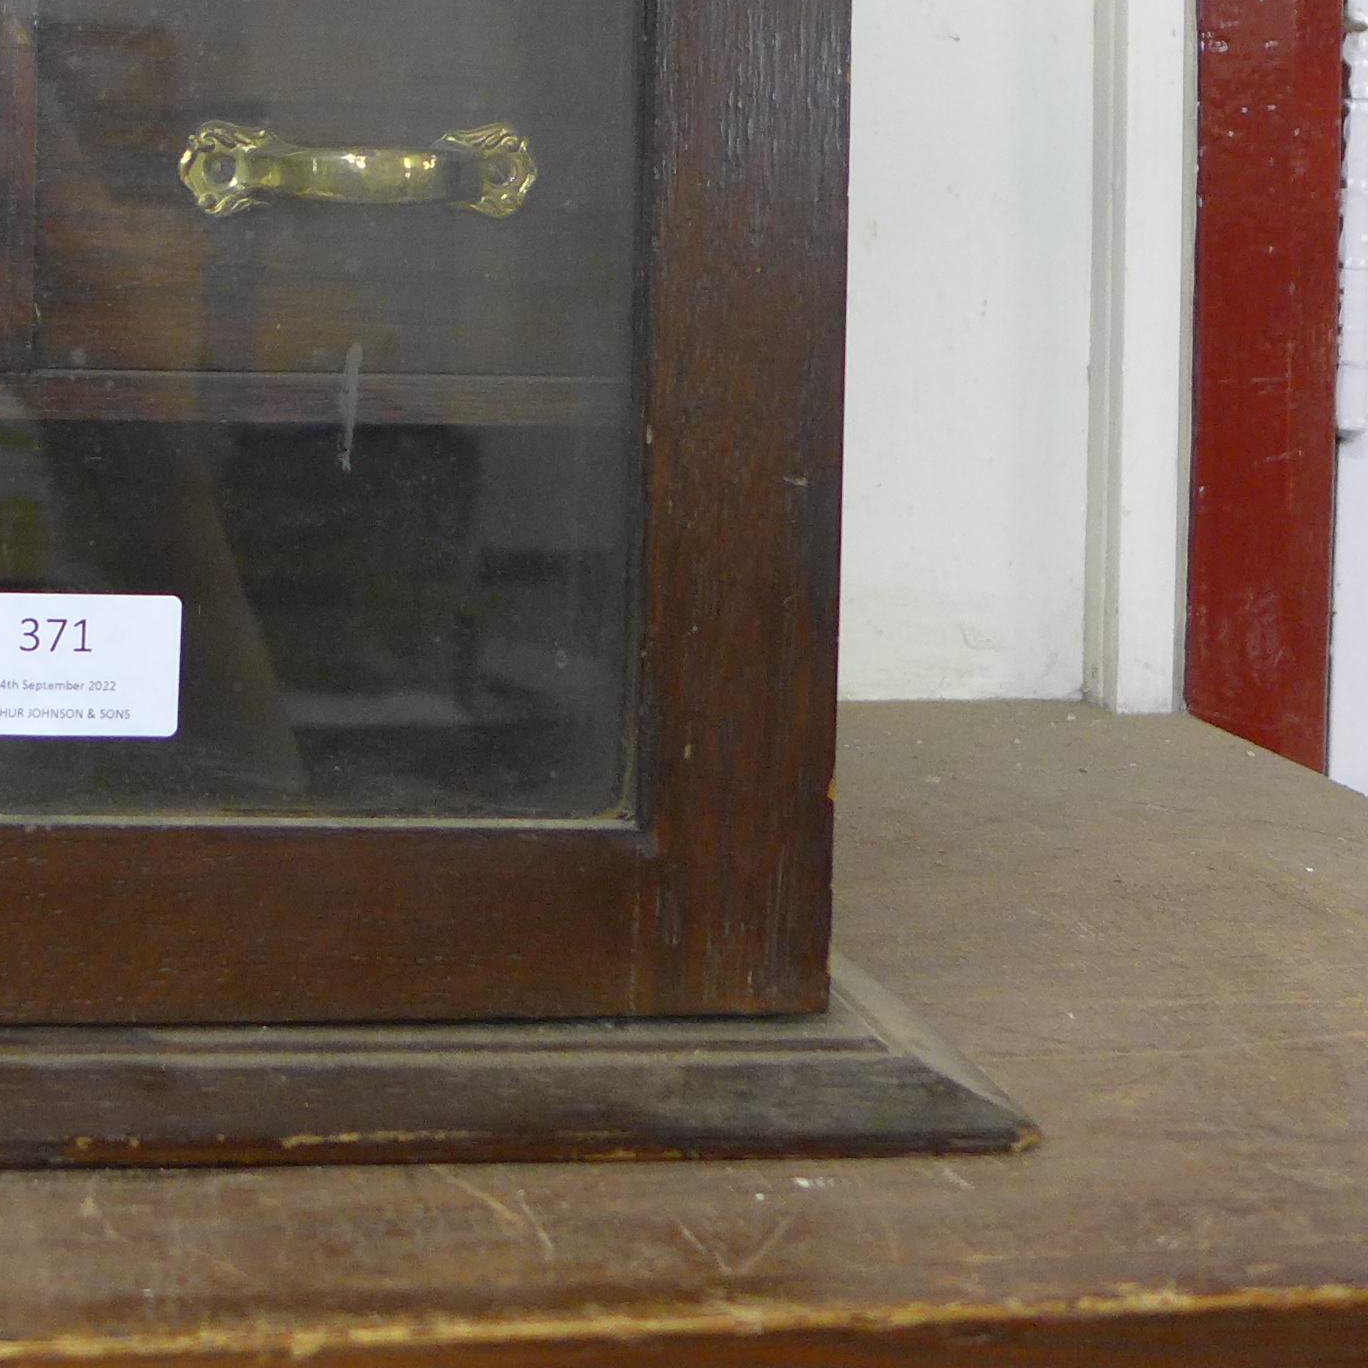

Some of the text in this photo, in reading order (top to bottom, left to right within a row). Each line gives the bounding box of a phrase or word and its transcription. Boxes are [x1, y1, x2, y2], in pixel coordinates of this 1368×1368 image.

[18, 617, 93, 653] 371
[21, 679, 85, 692] September
[88, 680, 117, 692] 2022
[27, 707, 84, 720] JOHNSON
[87, 708, 96, 720] &
[99, 708, 131, 720] SONS
